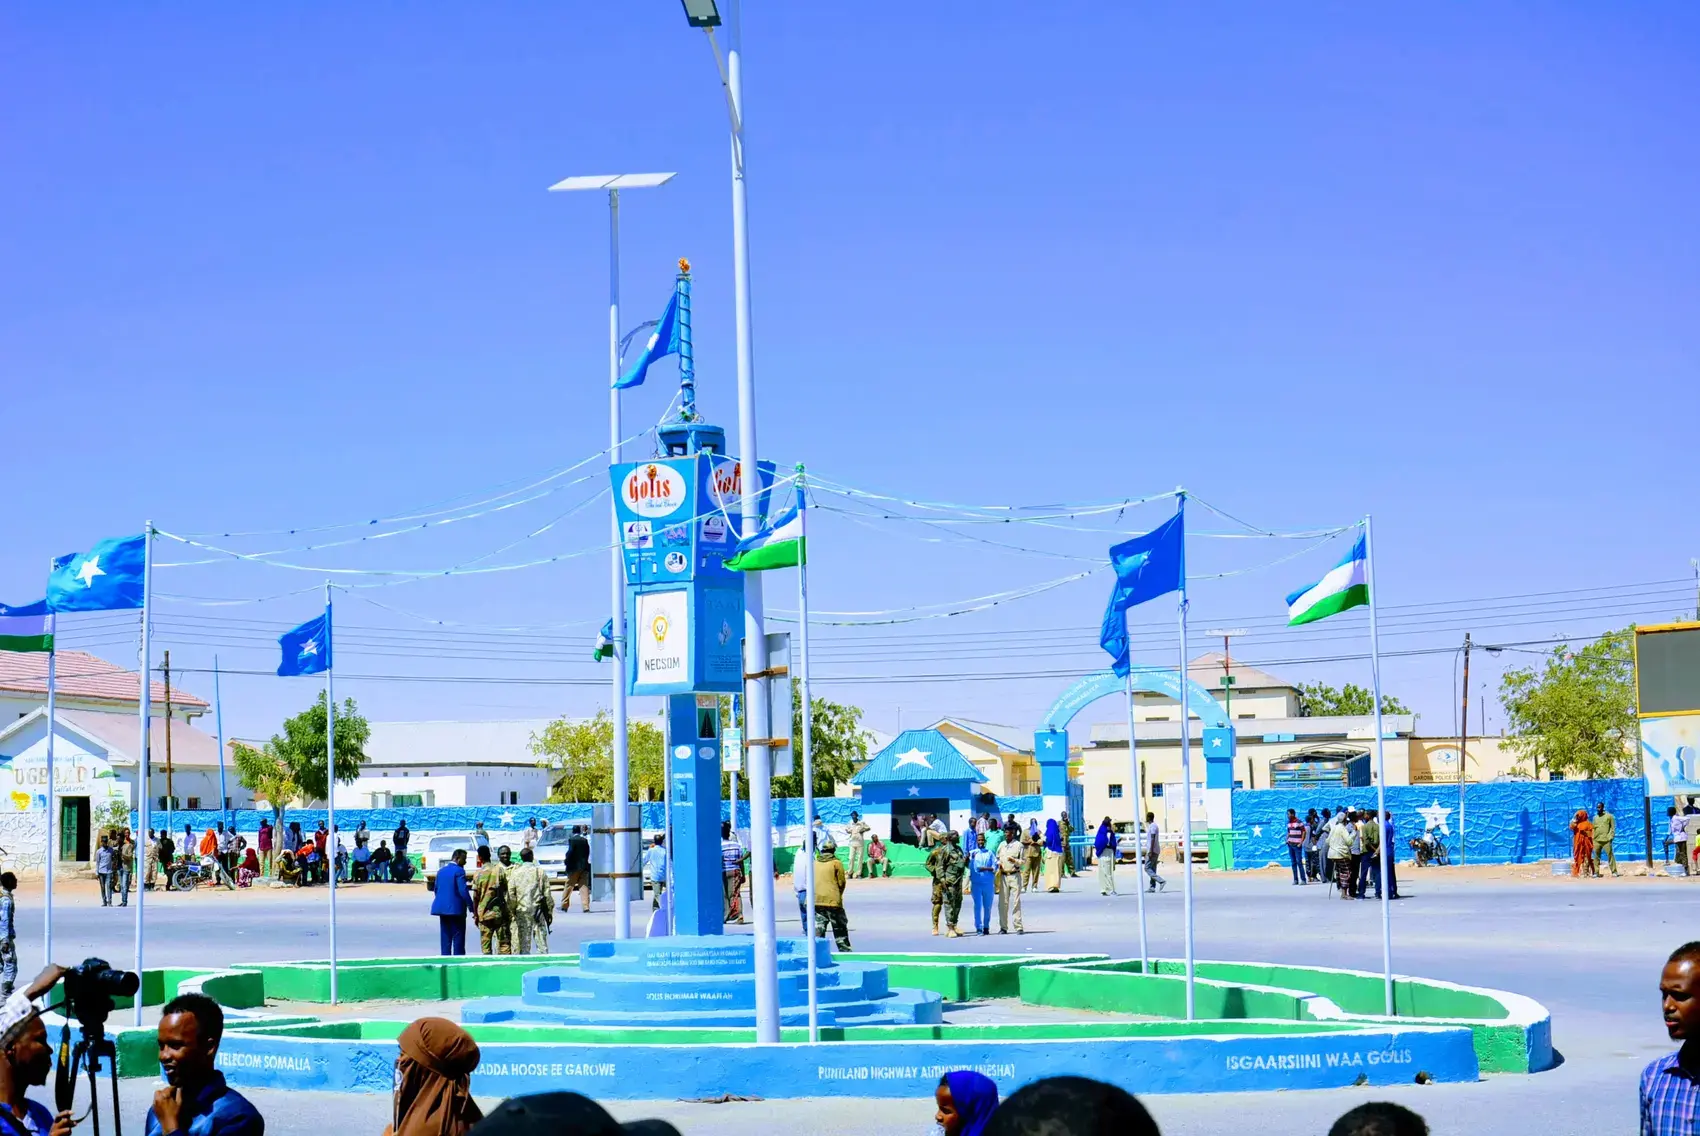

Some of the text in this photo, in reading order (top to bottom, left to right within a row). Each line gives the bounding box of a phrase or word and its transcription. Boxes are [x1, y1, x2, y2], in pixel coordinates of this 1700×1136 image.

[629, 466, 671, 503] Golis
[713, 463, 742, 497] Goli
[644, 657, 681, 671] NECSOM
[218, 1052, 311, 1071] TELECOM SOMALIA
[1325, 1052, 1363, 1067] WAA
[1367, 1049, 1412, 1065] GOLIS
[511, 1063, 549, 1076] HOOSE
[551, 1063, 563, 1076] EE
[565, 1063, 616, 1076] GAROWE
[818, 1065, 868, 1080] PUNTLAND
[871, 1065, 918, 1079] HIGHWAY
